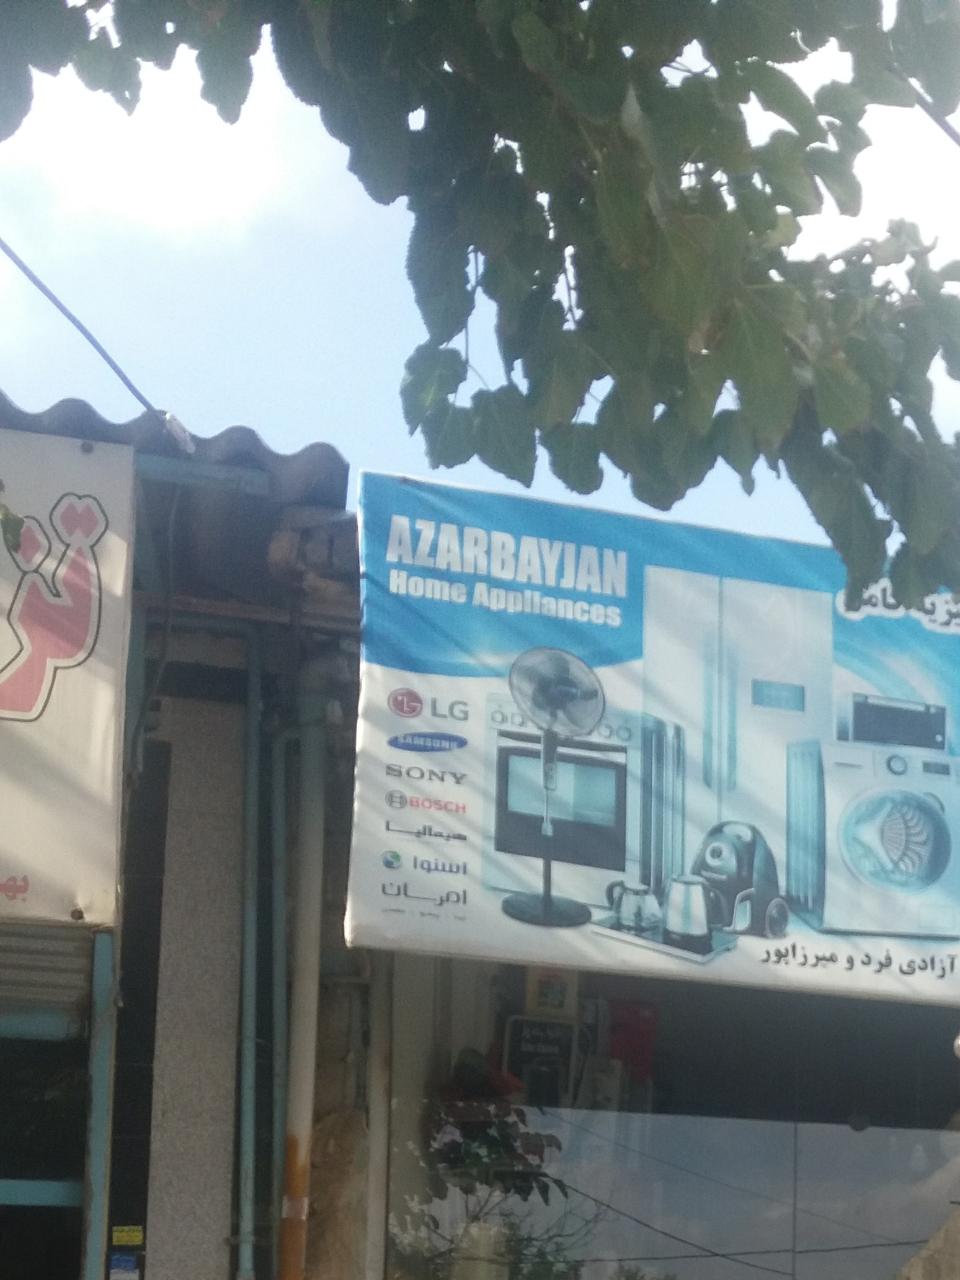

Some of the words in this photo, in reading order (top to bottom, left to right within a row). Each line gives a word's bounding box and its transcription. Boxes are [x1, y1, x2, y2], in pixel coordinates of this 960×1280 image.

[386, 514, 628, 598] AZARBAYJAN
[389, 569, 467, 604] Home
[472, 582, 622, 628] Appliances
[430, 696, 470, 721] LG
[385, 763, 468, 785] SONY
[409, 796, 467, 814] BOSCH
[413, 855, 468, 875] اسنوا
[845, 957, 855, 972] و
[860, 948, 893, 974] فرد
[898, 953, 956, 979] آزادی
